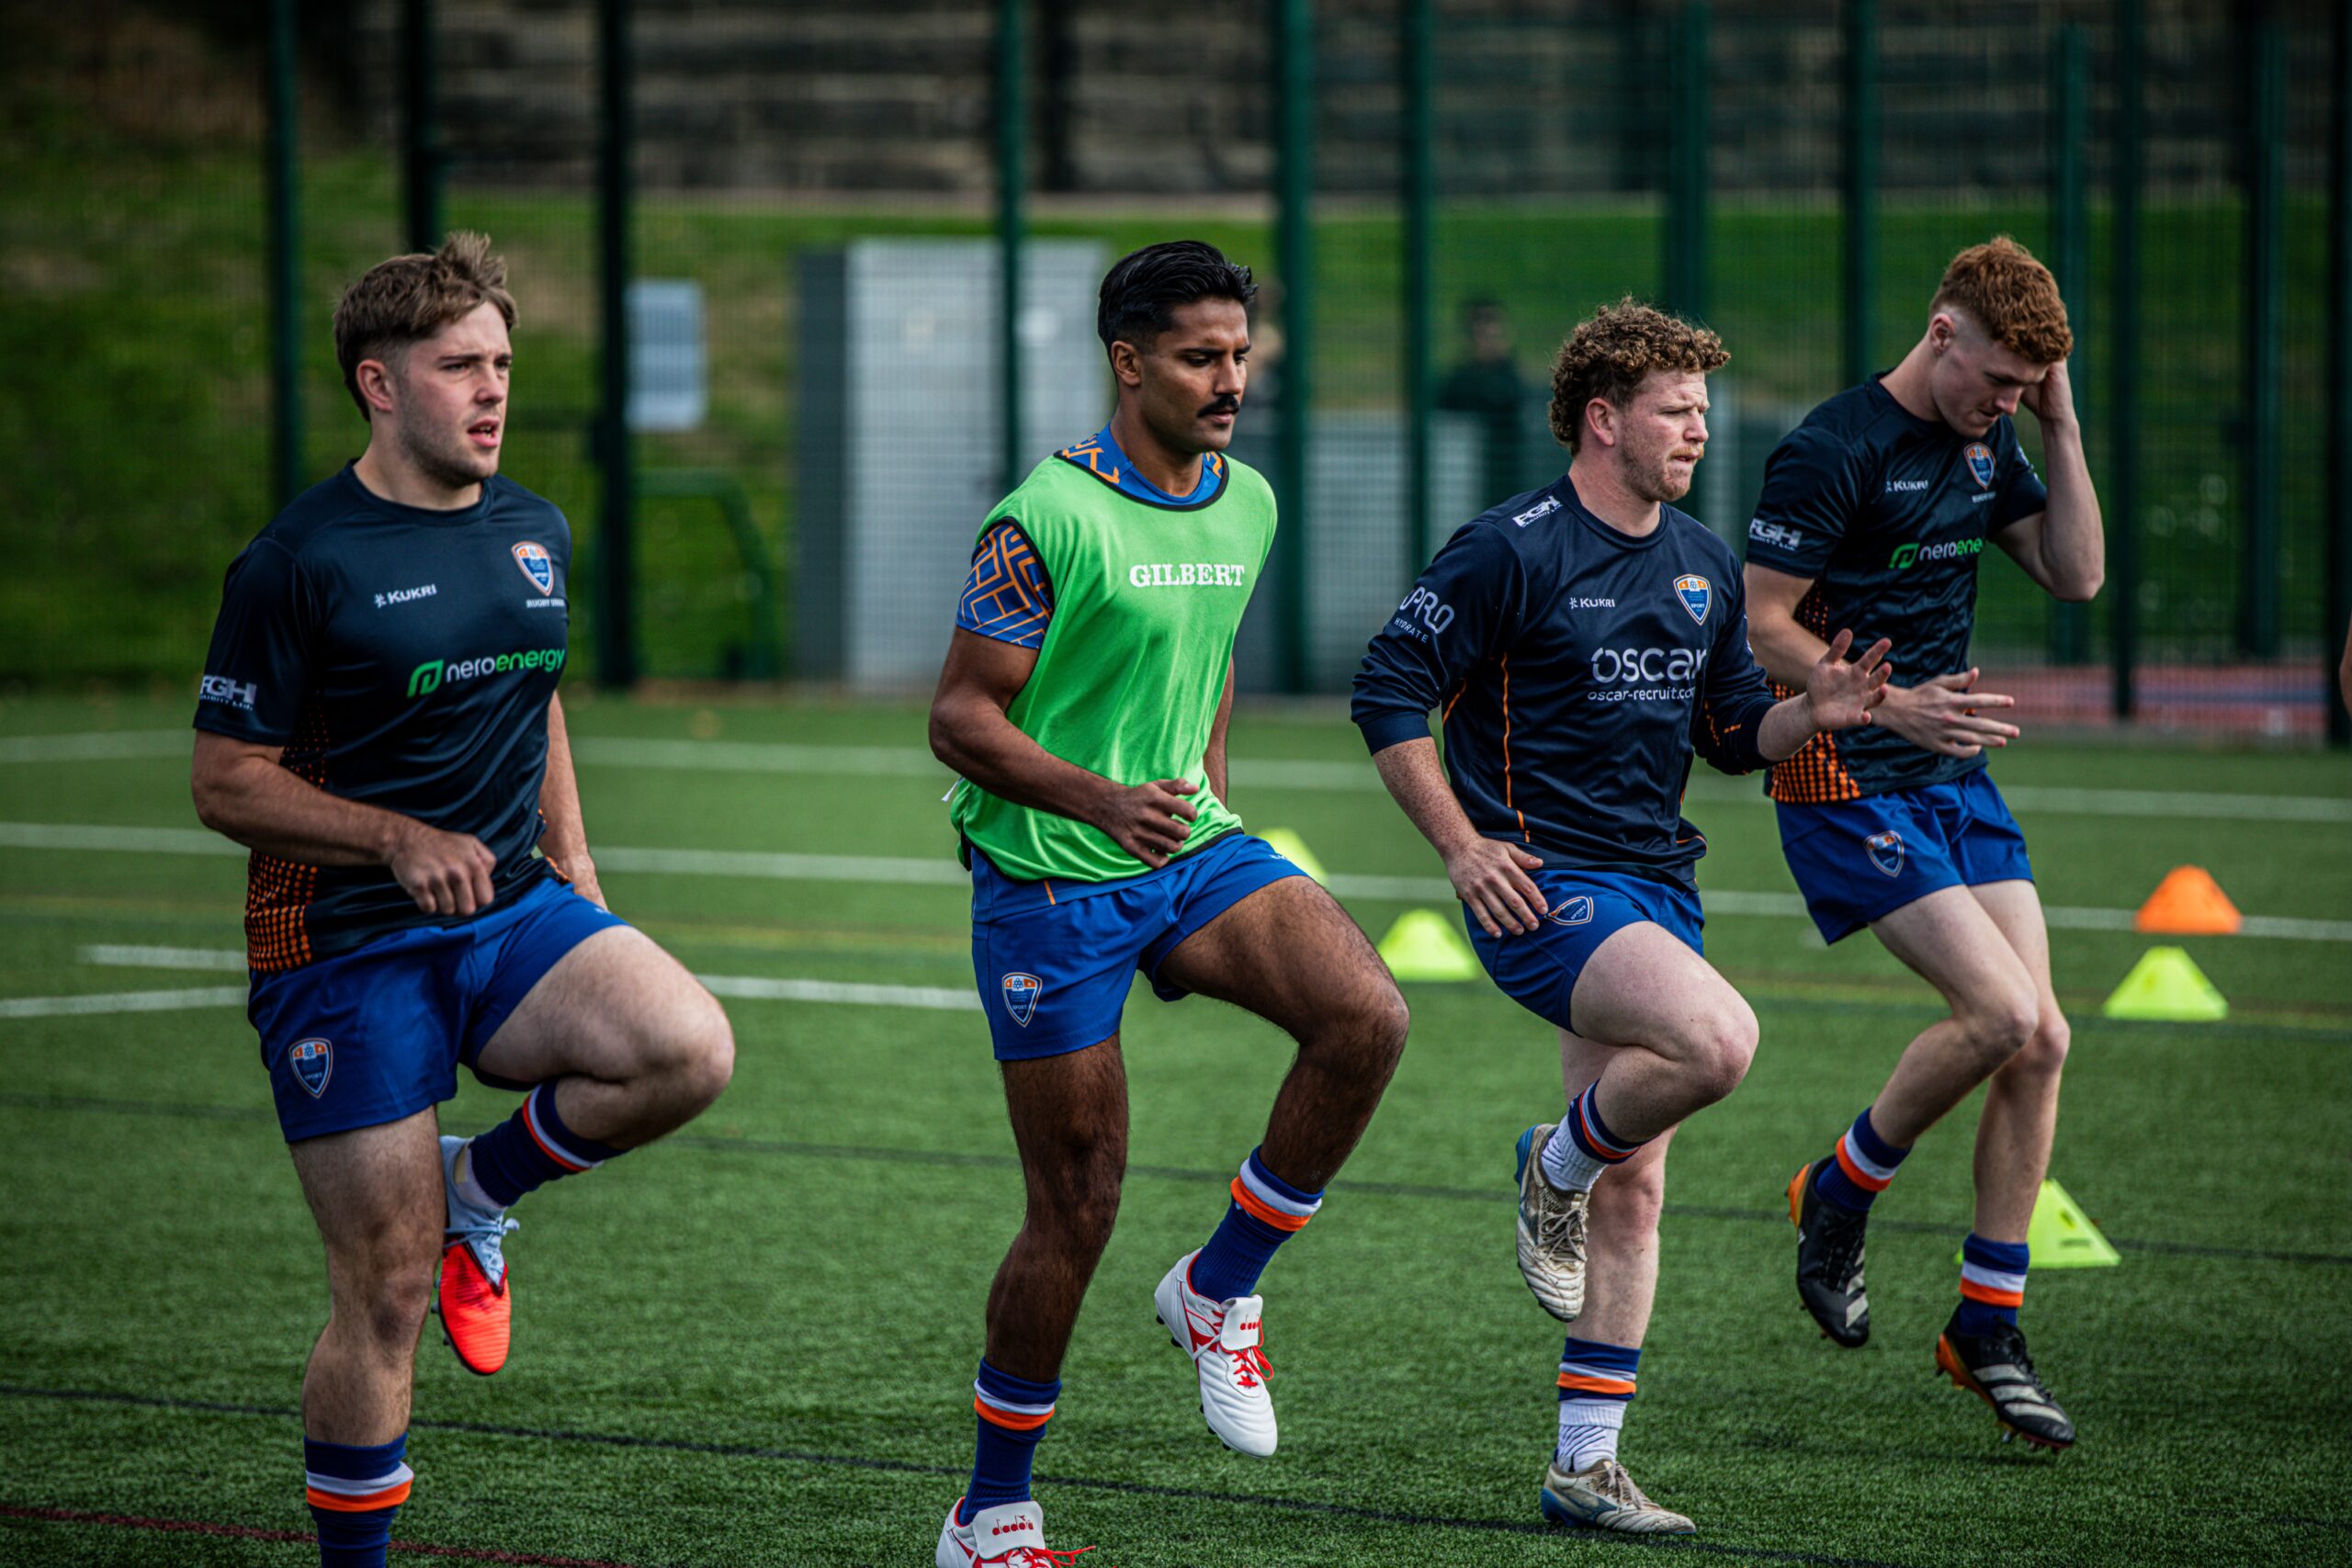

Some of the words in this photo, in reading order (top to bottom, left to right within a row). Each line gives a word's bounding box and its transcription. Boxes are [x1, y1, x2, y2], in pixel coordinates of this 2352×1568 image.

[1894, 479, 1928, 492] KUKRI
[1129, 563, 1245, 588] GILBERT
[387, 583, 437, 604] KUKRI
[1580, 597, 1616, 608] KUKRI
[1394, 617, 1429, 643] HYDRATE
[447, 649, 565, 682] neroenergy
[992, 1515, 1034, 1536] diadora
